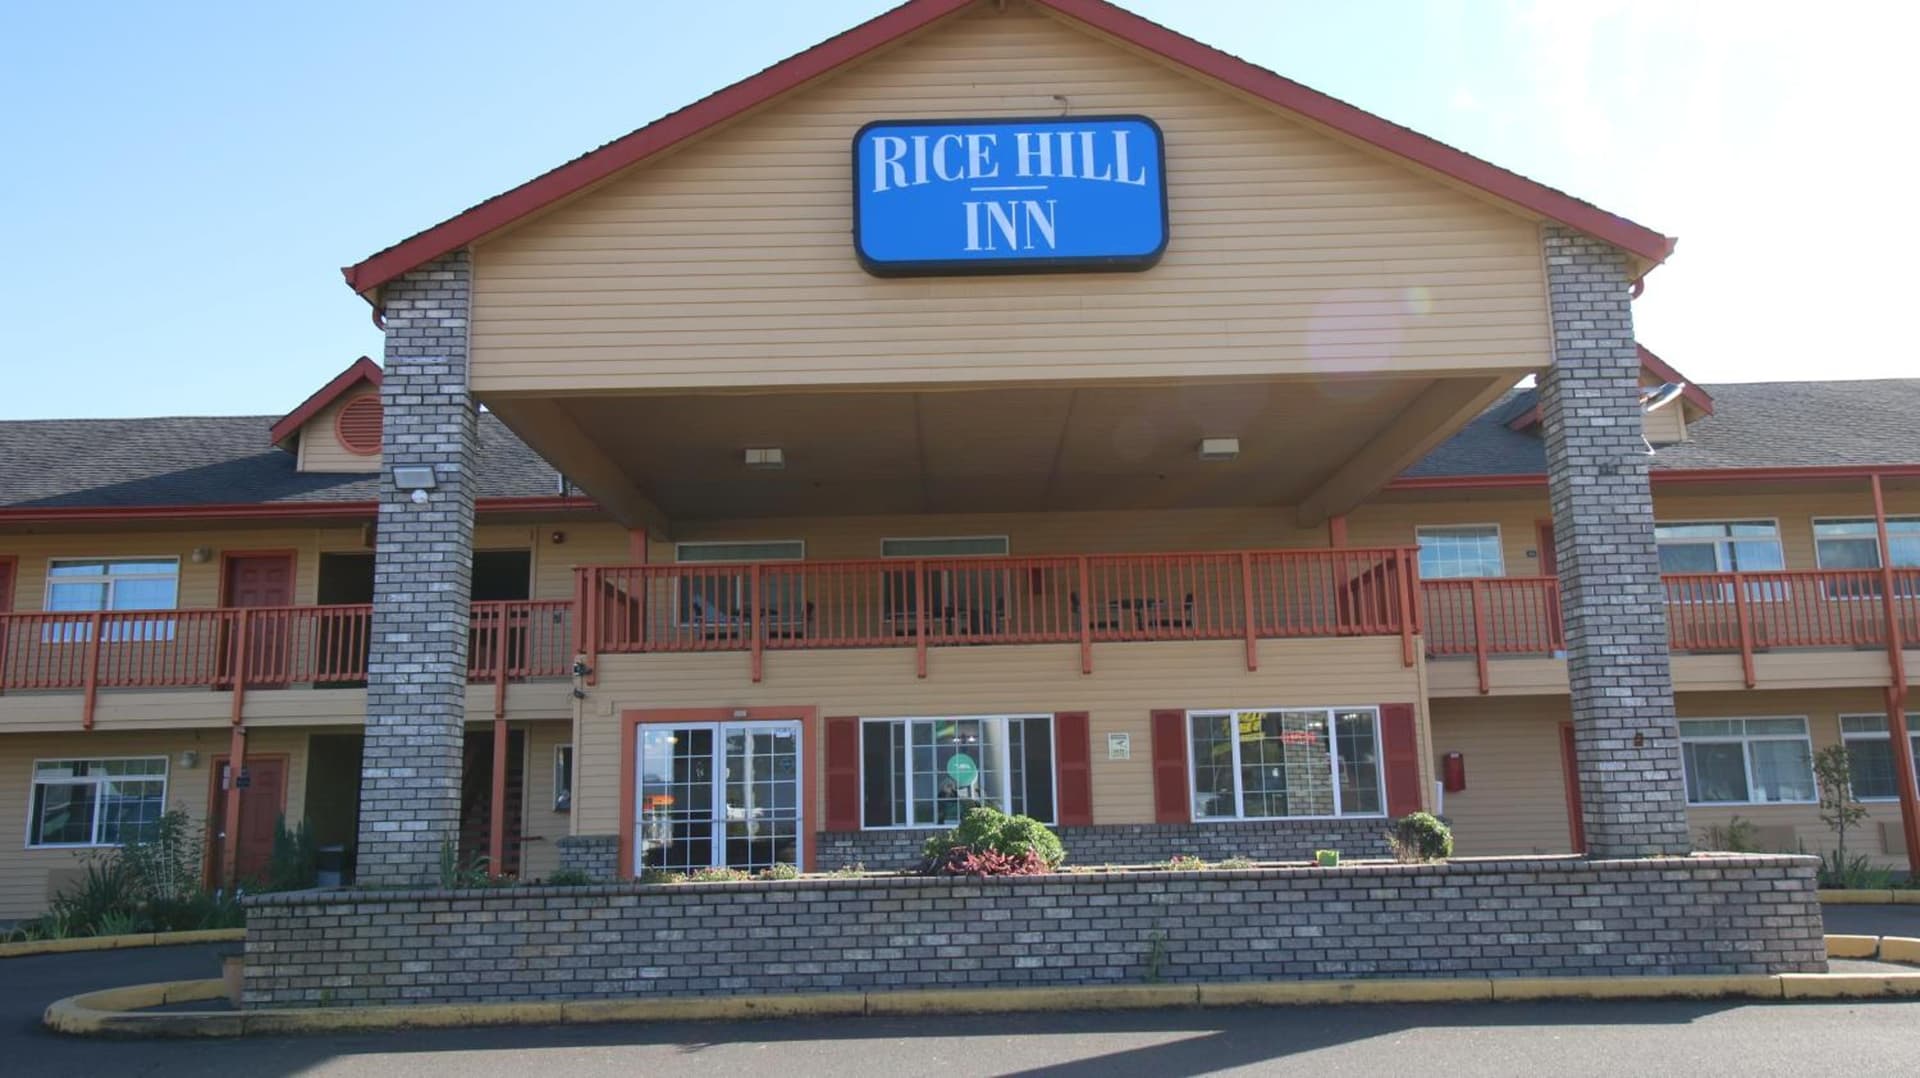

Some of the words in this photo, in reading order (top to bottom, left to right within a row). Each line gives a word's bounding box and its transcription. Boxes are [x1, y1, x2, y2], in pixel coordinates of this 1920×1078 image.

[872, 133, 999, 193] RICE
[1014, 130, 1146, 186] HILL
[962, 199, 1058, 251] INN
